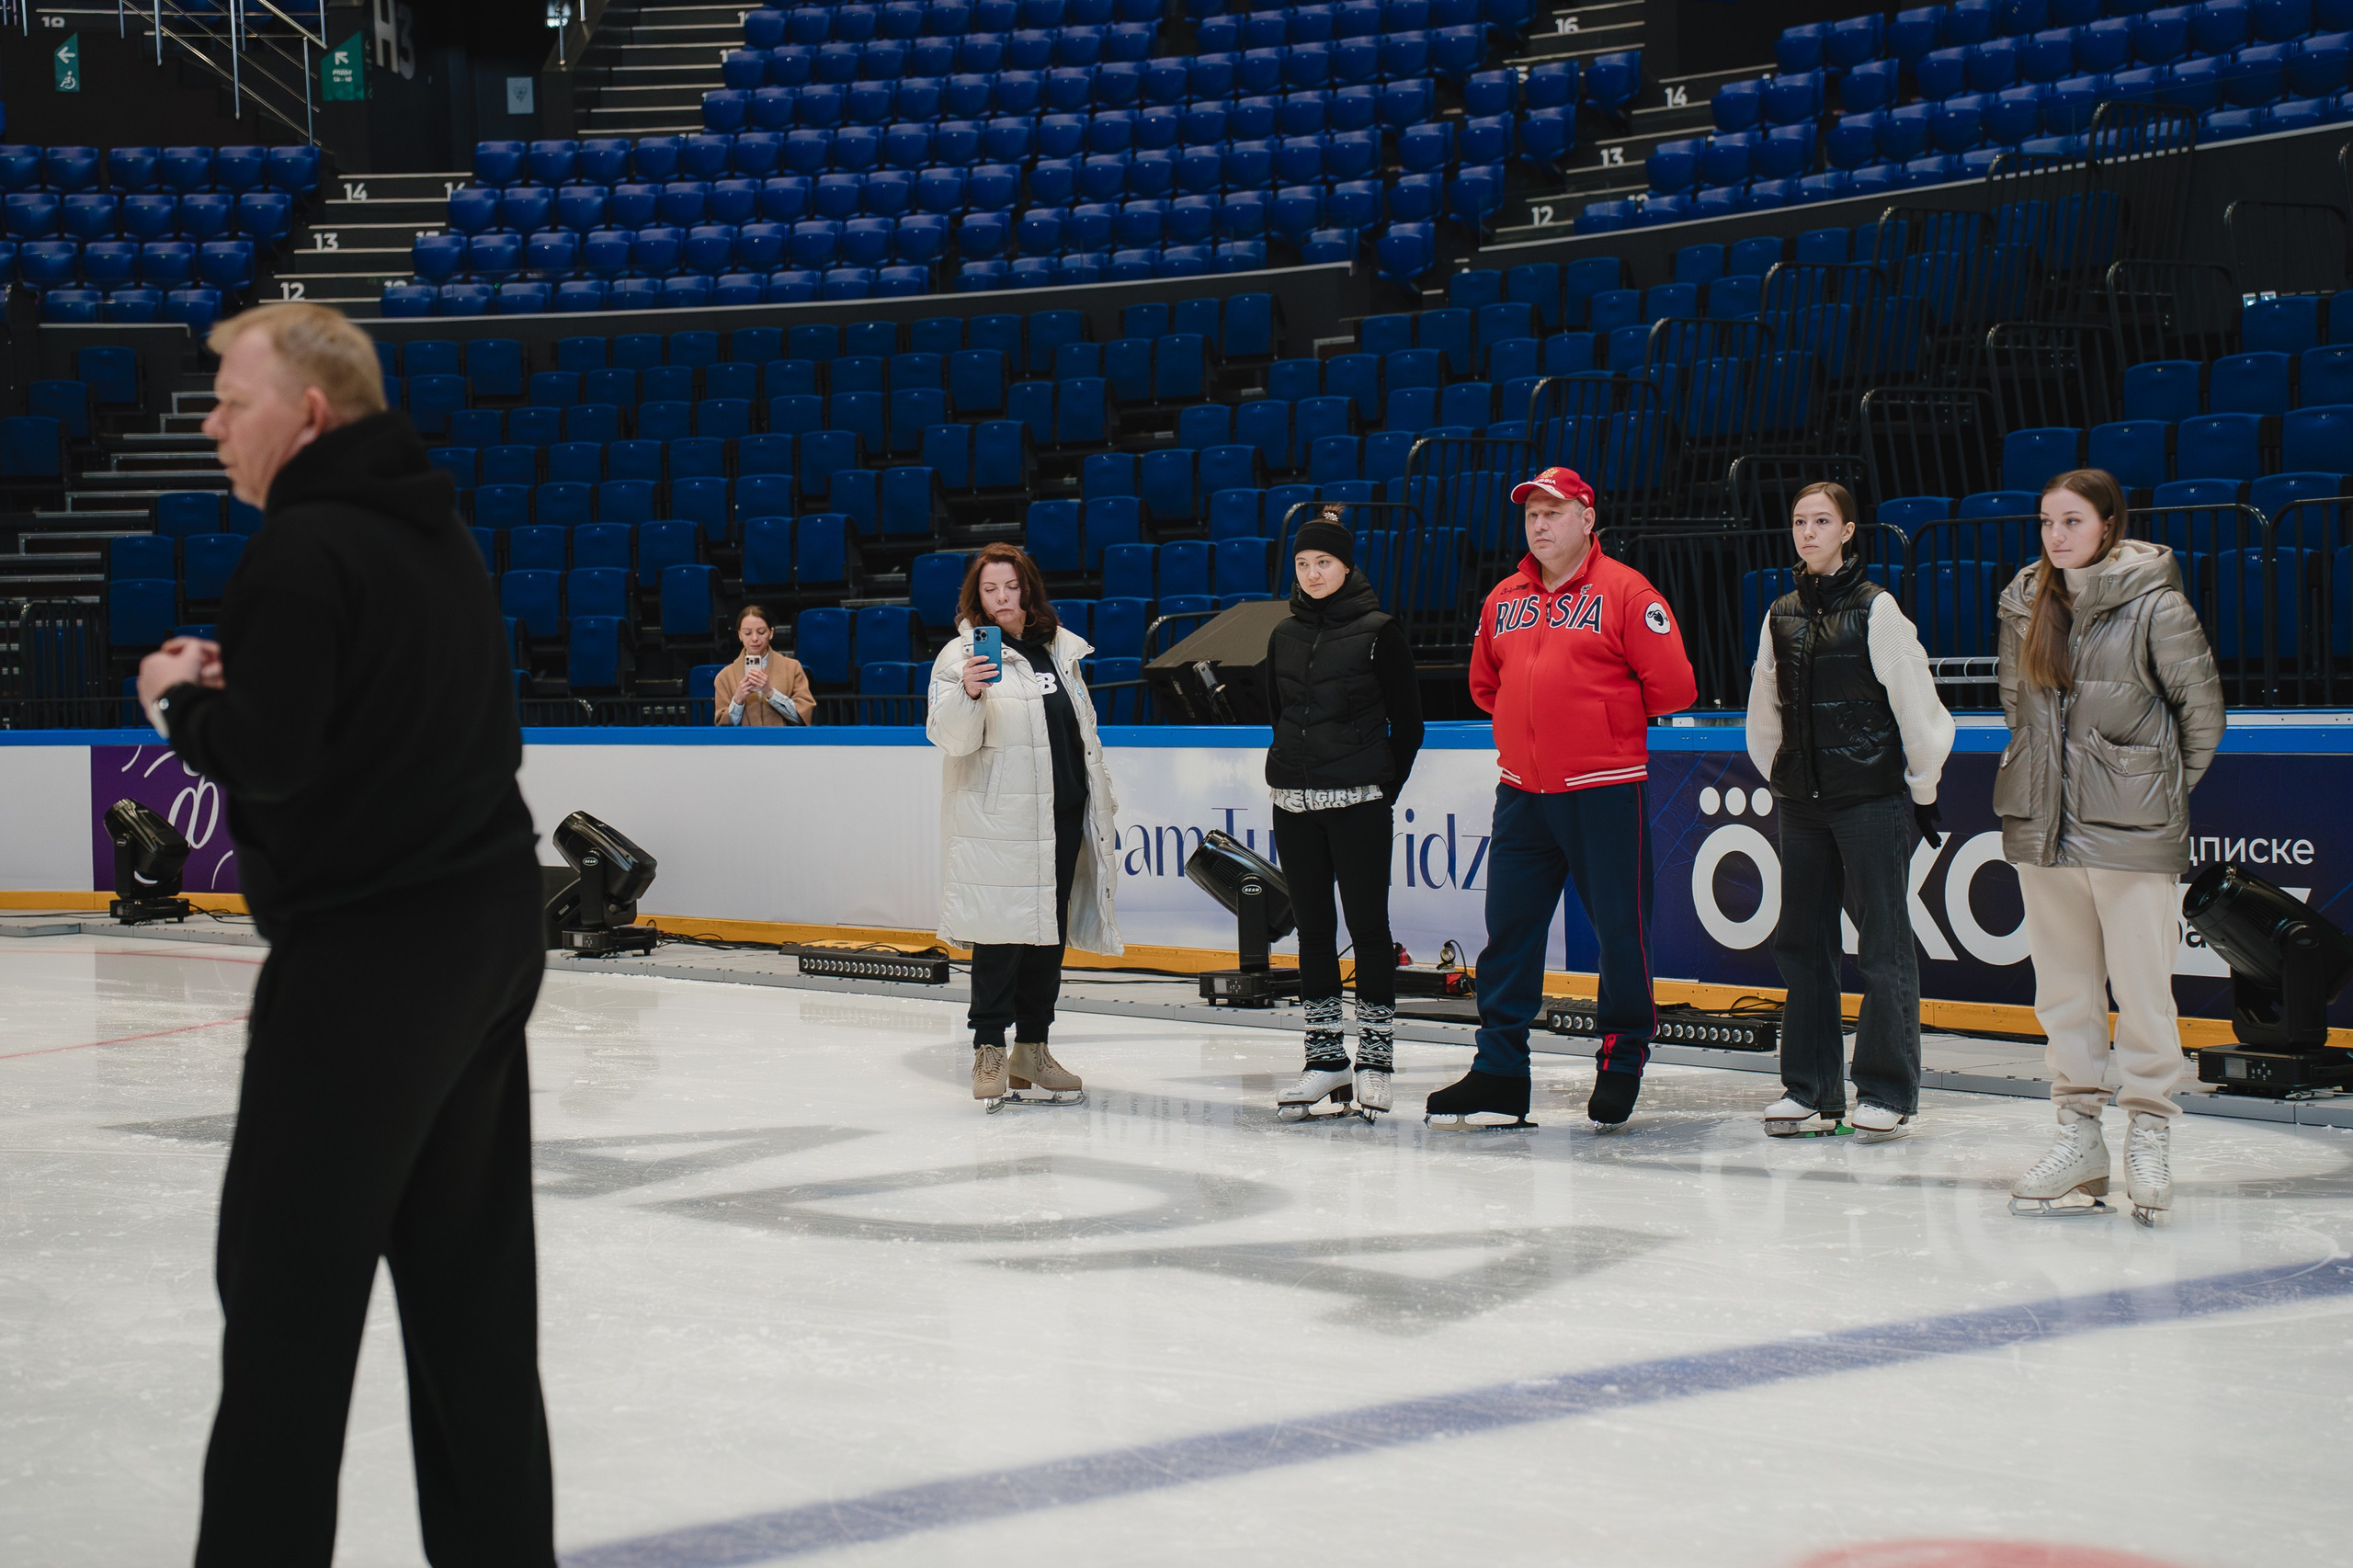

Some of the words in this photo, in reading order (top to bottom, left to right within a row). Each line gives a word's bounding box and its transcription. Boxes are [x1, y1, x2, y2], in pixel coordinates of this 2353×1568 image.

[1555, 17, 1579, 33] 16
[1665, 85, 1688, 108] 14
[1600, 147, 1624, 167] 13
[343, 183, 368, 202] 14
[1531, 206, 1554, 226] 12
[313, 233, 339, 251] 13
[279, 282, 306, 301] 12
[1493, 594, 1603, 639] RUSSIA
[2189, 836, 2315, 866] писке
